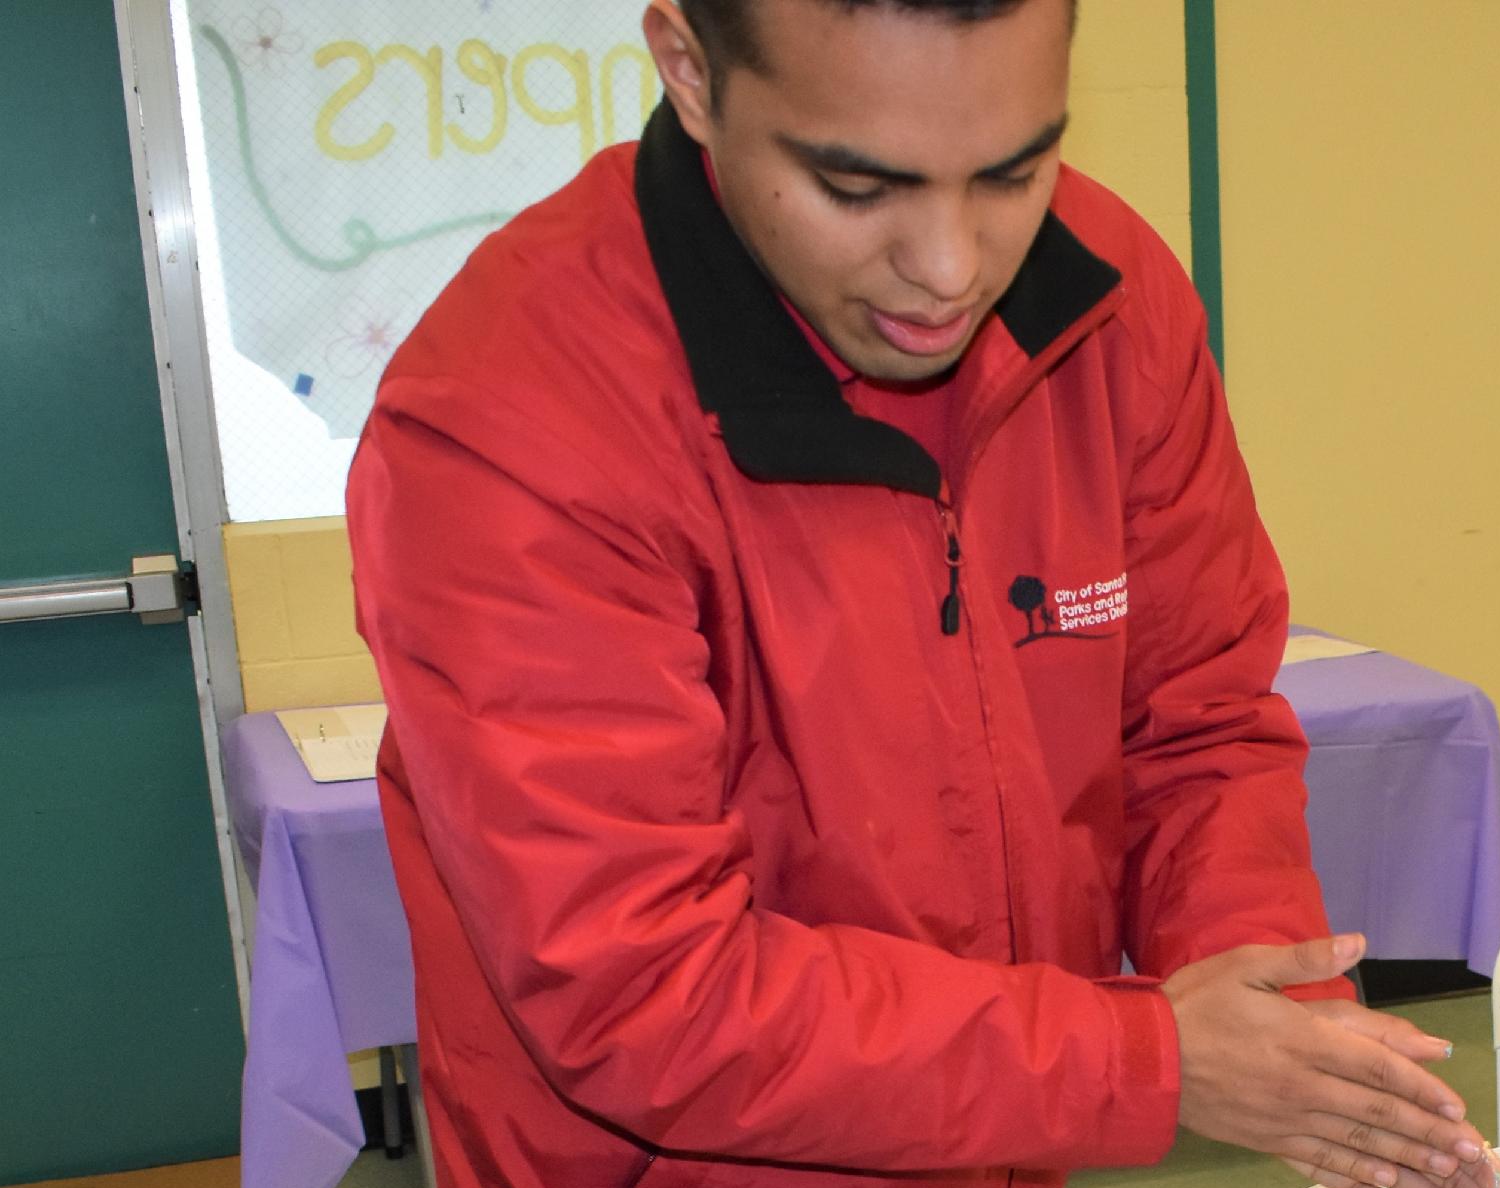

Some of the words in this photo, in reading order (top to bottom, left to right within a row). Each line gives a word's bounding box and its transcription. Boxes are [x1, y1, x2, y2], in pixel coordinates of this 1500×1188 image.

[1055, 590, 1077, 603] City
[1080, 584, 1092, 598] of
[1094, 578, 1122, 595] Santa
[1059, 603, 1091, 618] Parks
[1094, 595, 1114, 611] and
[1060, 612, 1108, 631] Services
